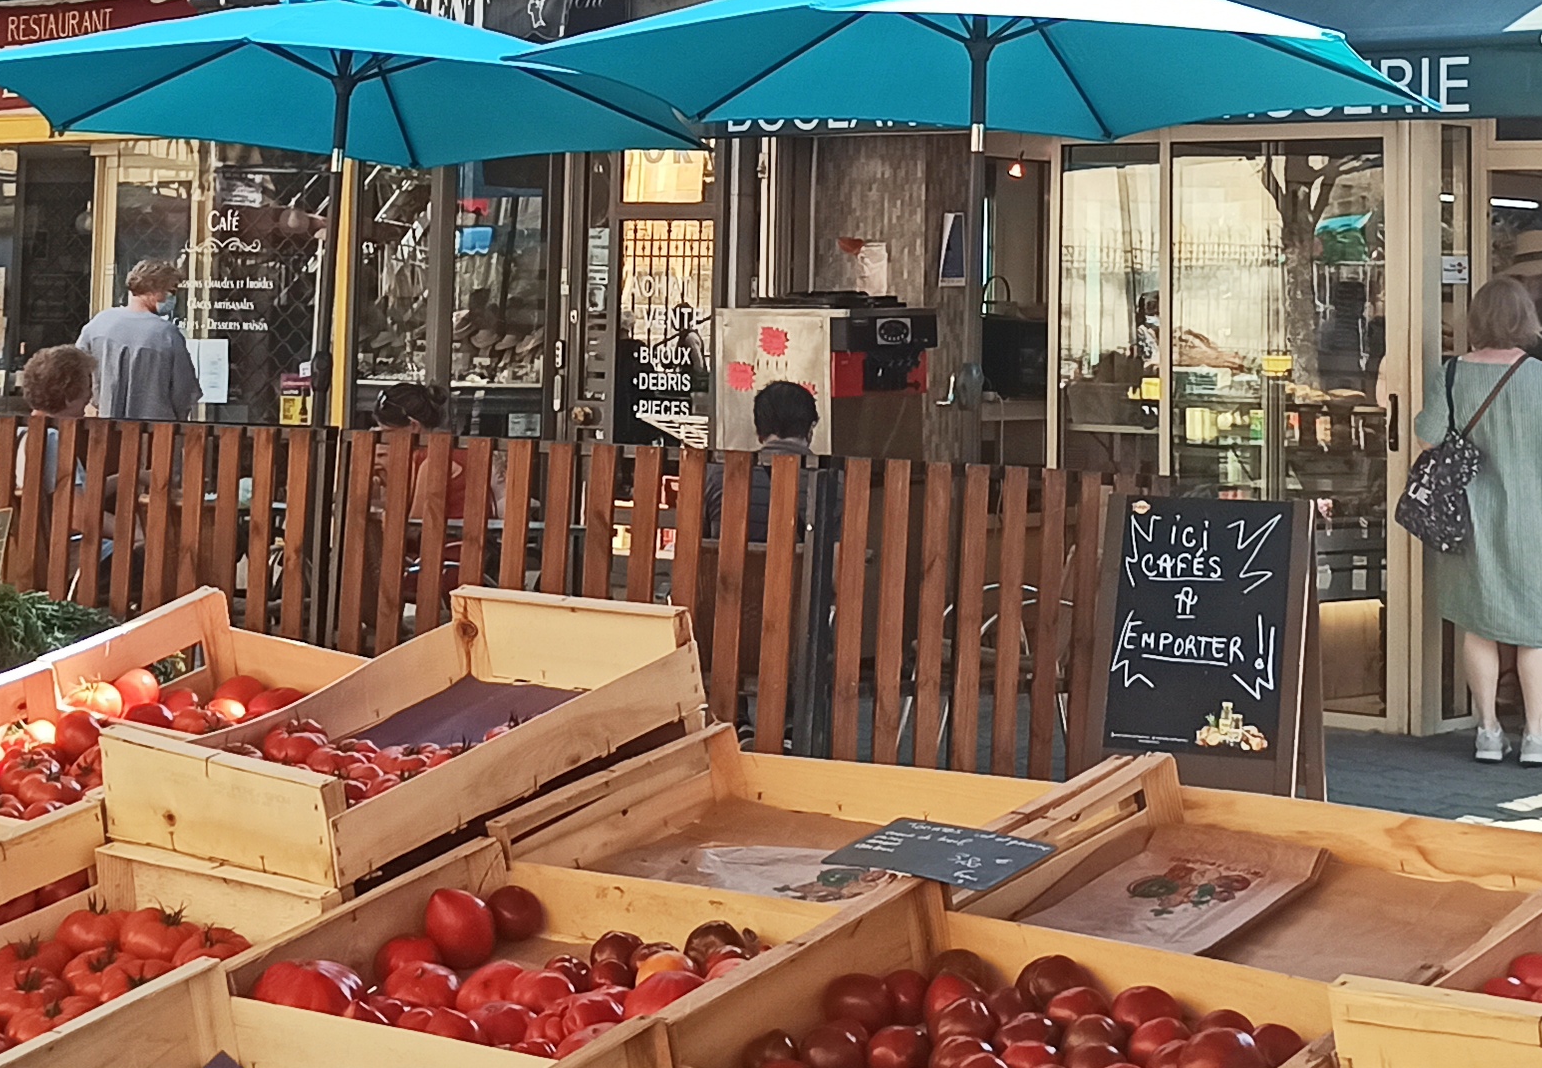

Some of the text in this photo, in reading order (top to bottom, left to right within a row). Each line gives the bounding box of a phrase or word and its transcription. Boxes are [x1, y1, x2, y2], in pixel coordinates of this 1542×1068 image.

[8, 8, 113, 42] RESTAURANT
[630, 275, 691, 299] ACHAT
[643, 307, 704, 330] VENTE
[639, 346, 691, 366] BIJOUX
[638, 373, 691, 392] DEBRIS
[639, 399, 690, 417] PIECES
[1141, 547, 1222, 578] CAFÉS
[1123, 620, 1246, 664] EMPORTER
